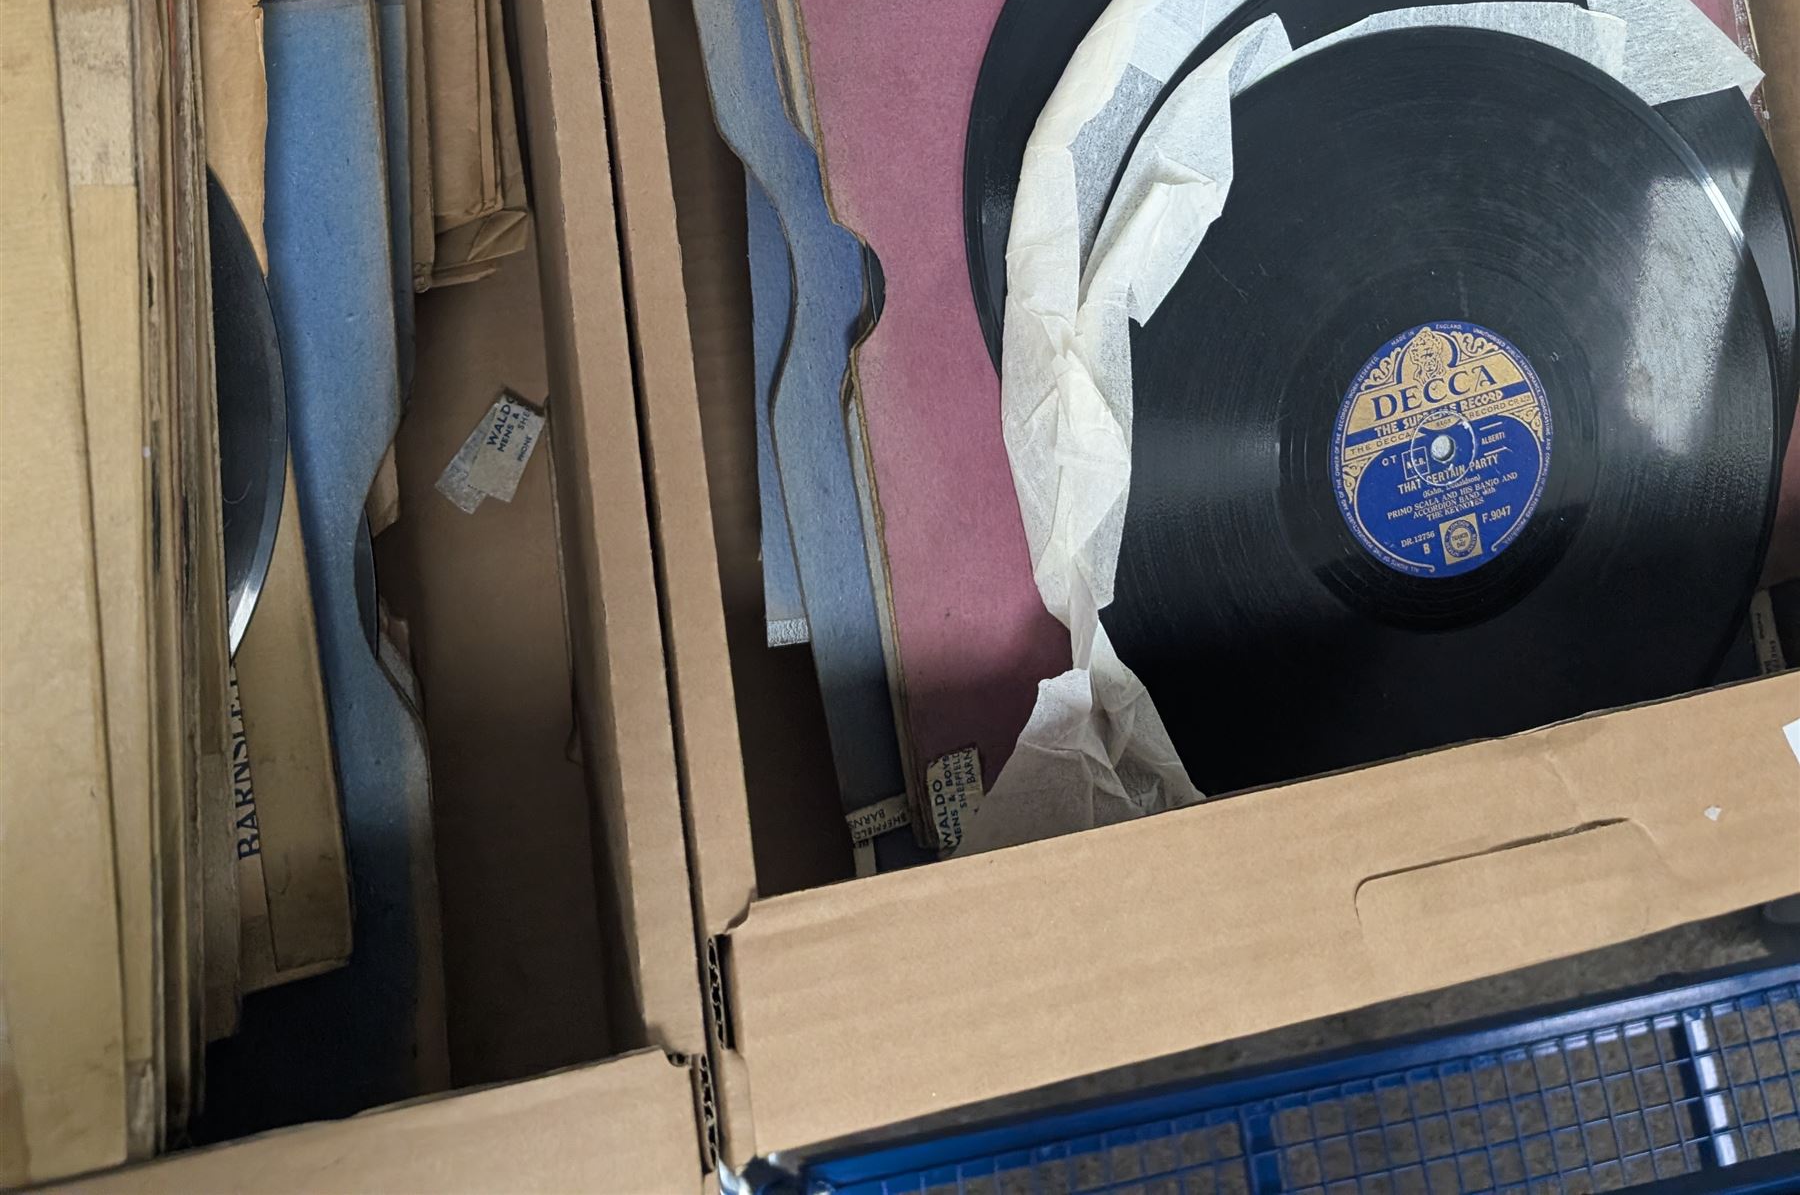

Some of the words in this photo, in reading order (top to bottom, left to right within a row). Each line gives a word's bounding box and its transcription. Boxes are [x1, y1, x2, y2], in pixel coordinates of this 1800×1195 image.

[1390, 333, 1406, 347] MADE
[1407, 330, 1414, 338] IN
[1371, 364, 1497, 422] DECCA
[1349, 442, 1373, 456] THE
[1376, 429, 1412, 449] DECCA
[1468, 401, 1507, 420] RECORD
[1374, 421, 1400, 438] THE
[1460, 389, 1503, 410] RECORD
[497, 424, 514, 453] MENS
[1397, 479, 1421, 494] THAT
[1426, 465, 1465, 485] CERTAIN
[1469, 454, 1498, 472] PARTY
[1387, 506, 1413, 520] PRIMO
[1414, 497, 1439, 510] SCALA
[1442, 491, 1457, 501] AND
[1460, 486, 1473, 496] HIS
[1475, 479, 1500, 491] BANJO
[1502, 471, 1518, 483] AND
[1413, 499, 1457, 519] ACCORDION
[1459, 492, 1480, 504] BAND
[1426, 511, 1444, 521] THE
[1445, 497, 1485, 515] KEYNOTES
[1481, 505, 1511, 524] F.9047
[1422, 544, 1431, 555] B
[932, 779, 957, 848] WALDO
